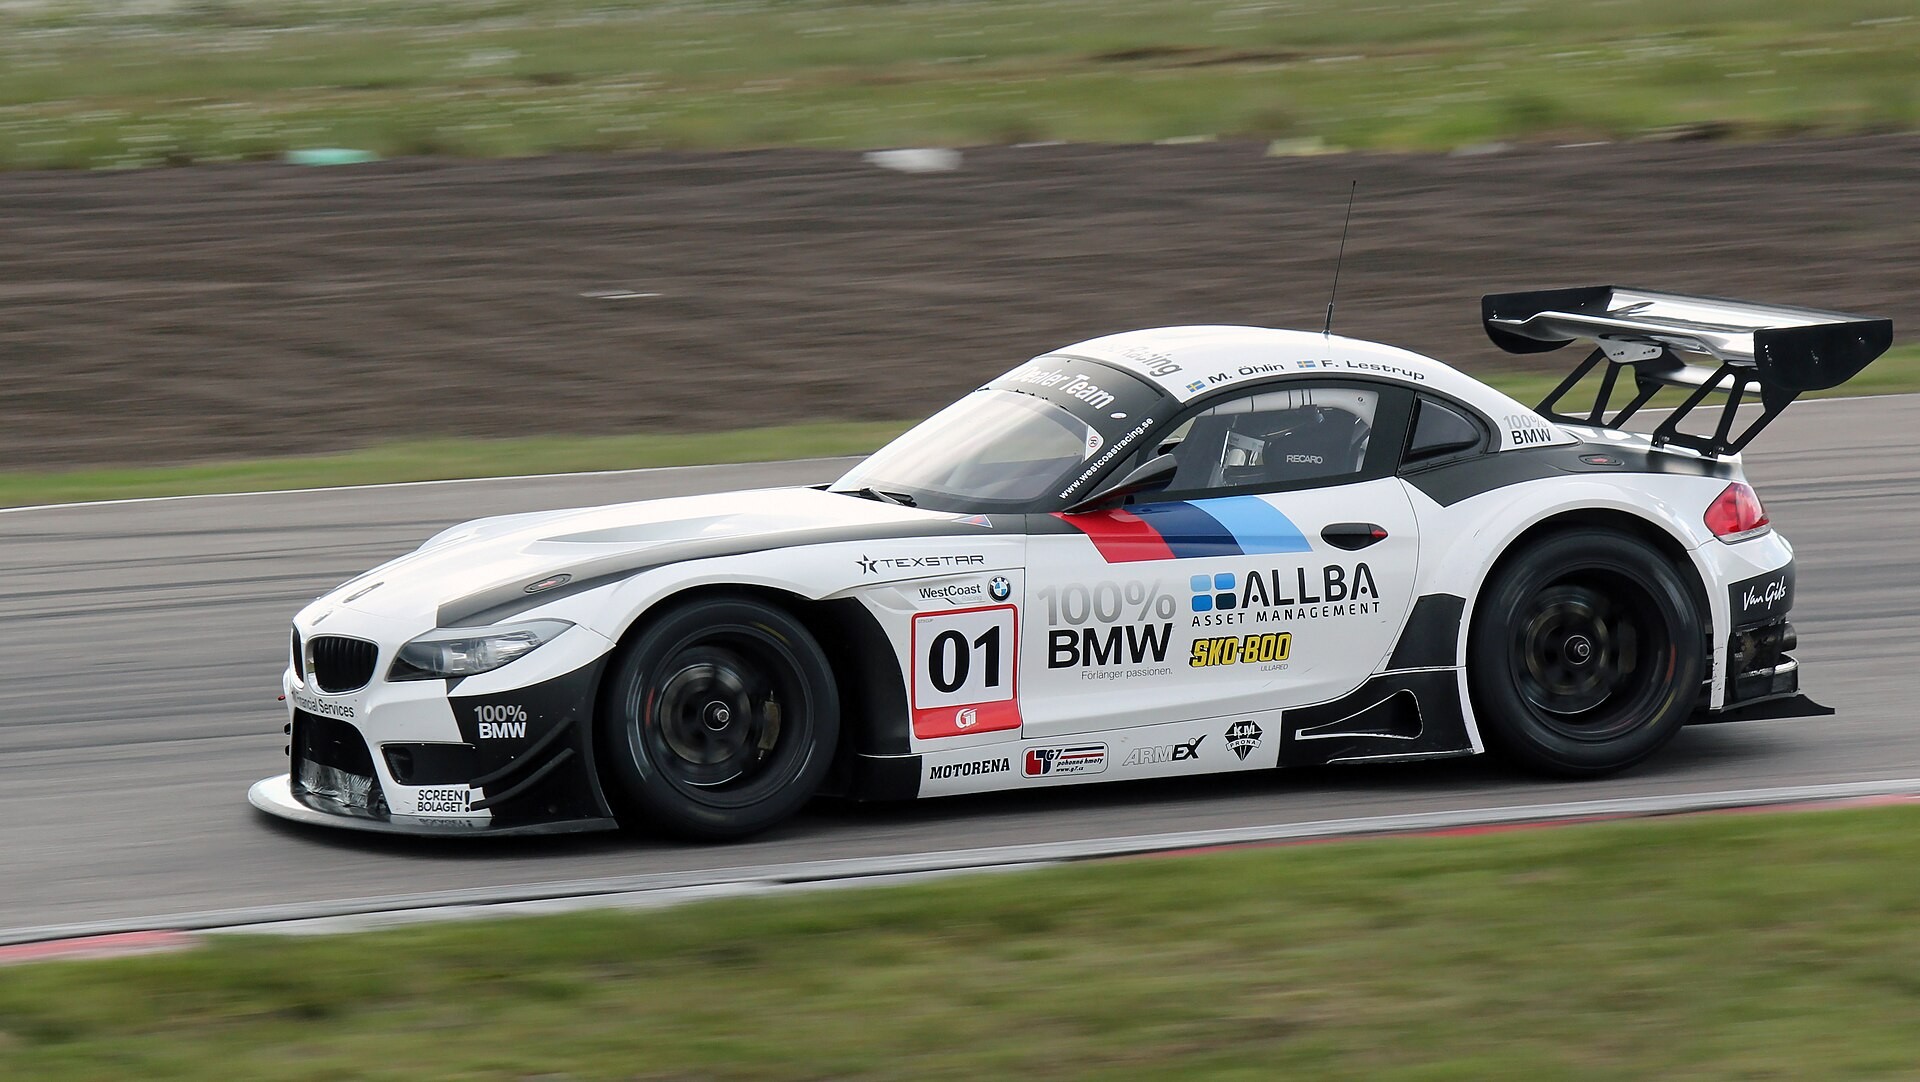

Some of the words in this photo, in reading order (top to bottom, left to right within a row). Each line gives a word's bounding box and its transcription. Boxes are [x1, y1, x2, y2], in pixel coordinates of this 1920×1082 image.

[1208, 373, 1233, 384] M.
[1238, 362, 1285, 376] Öhlin
[1321, 359, 1339, 368] F.
[1346, 360, 1425, 381] Lestrup
[1010, 366, 1070, 387] Dealer
[1059, 374, 1115, 410] Team
[1503, 414, 1548, 429] 100%
[1511, 429, 1552, 445] BMW
[1059, 417, 1154, 499] www.westcoastracing.se
[1286, 454, 1324, 465] RECARO
[880, 554, 985, 568] TEXSTAR
[918, 583, 982, 599] WestCoast
[1241, 562, 1379, 609] ALLBA
[1743, 585, 1764, 611] Van
[1765, 575, 1787, 610] Gils
[1037, 578, 1177, 626] 100%
[1191, 612, 1246, 627] ASSET
[1256, 601, 1380, 623] MANAGEMENT
[1048, 623, 1173, 669] BMW
[1189, 632, 1292, 668] SKO-BOO
[928, 625, 1000, 693] 01
[1260, 663, 1289, 672] ULLARED
[1081, 669, 1124, 681] Förlänger
[1126, 667, 1173, 679] passionen.
[292, 691, 319, 712] nancial
[318, 698, 355, 718] Services
[473, 705, 528, 722] 100%
[478, 722, 527, 739] BMW
[1233, 724, 1255, 737] KM
[1045, 749, 1064, 761] G7
[1122, 734, 1208, 766] ARMEX
[929, 757, 1011, 780] MOTORENA
[418, 789, 463, 802] SCREEN
[417, 801, 463, 813] BOLAGET
